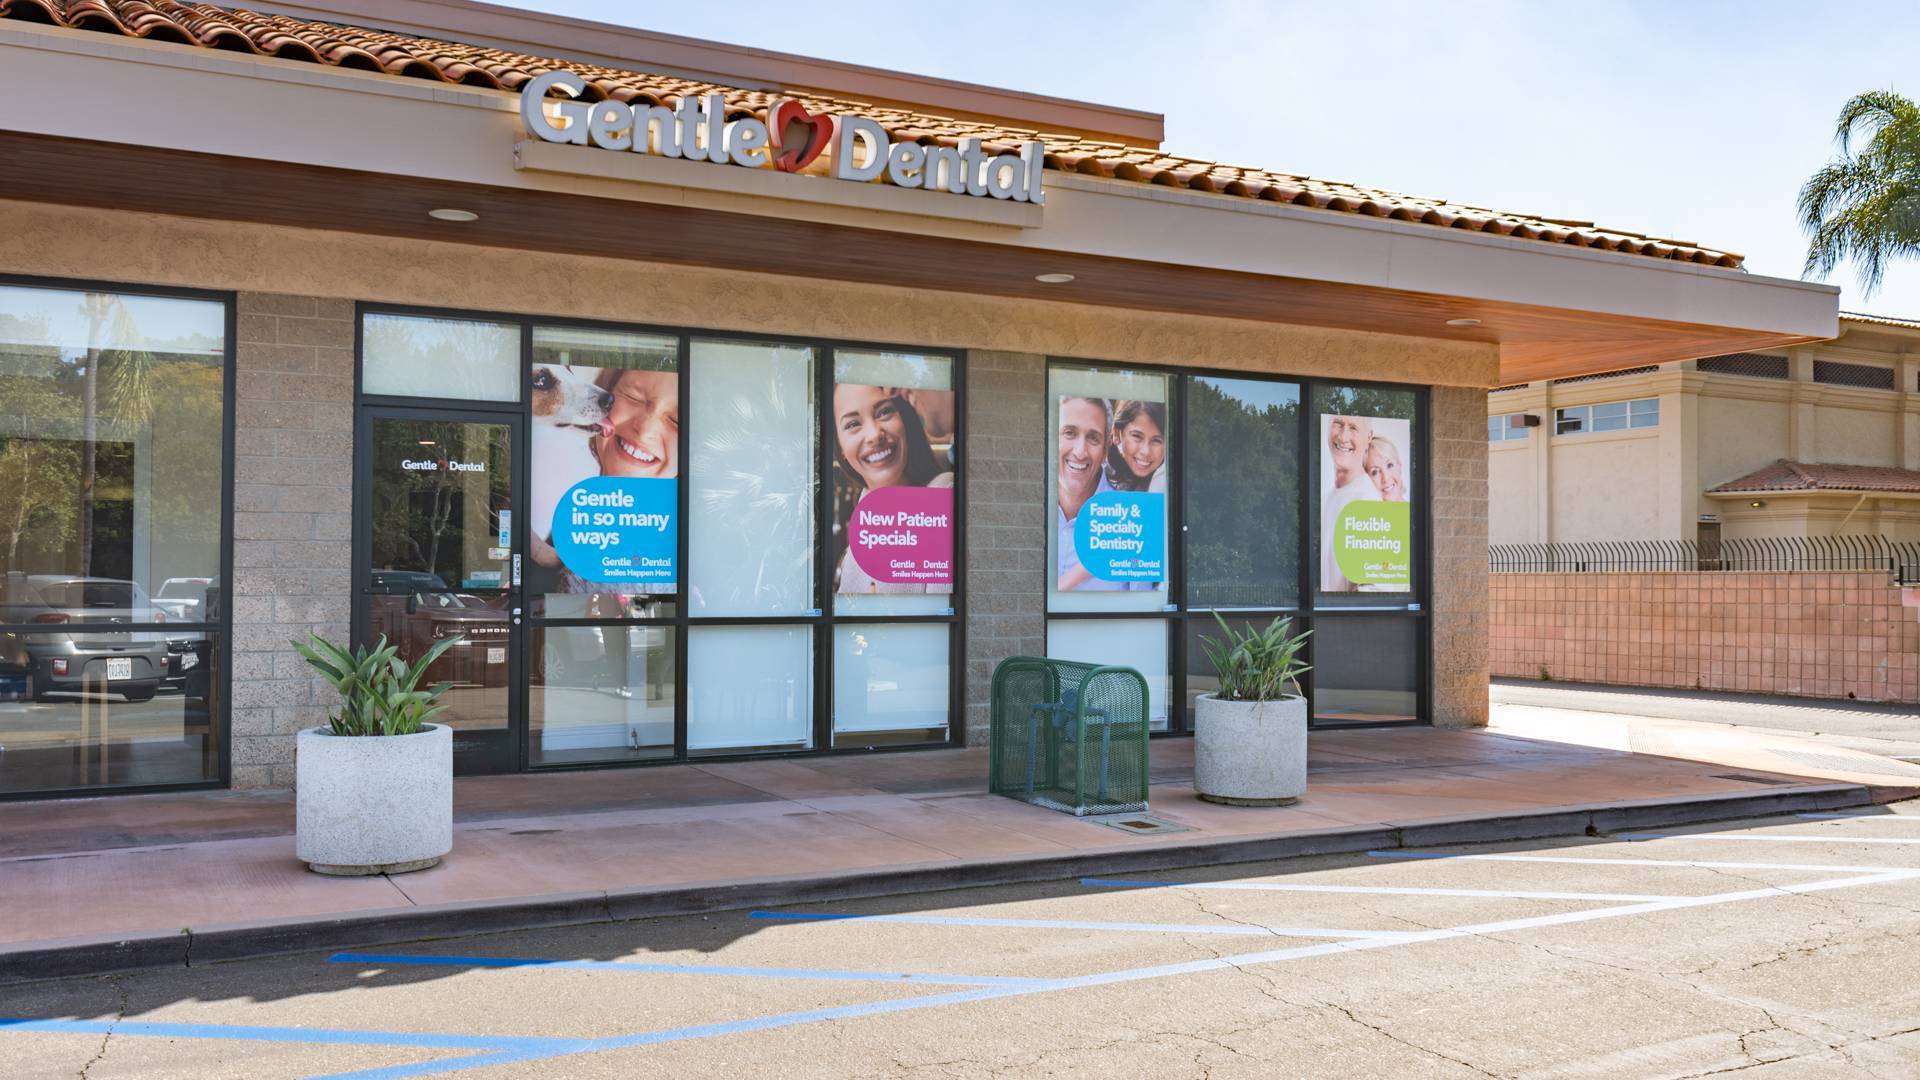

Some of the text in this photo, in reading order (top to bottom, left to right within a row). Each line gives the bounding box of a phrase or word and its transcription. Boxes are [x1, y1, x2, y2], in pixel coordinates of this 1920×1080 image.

[521, 70, 1045, 205] Gentle Dental
[401, 459, 485, 472] Gentle Dental
[571, 488, 635, 508] Gentle
[572, 507, 670, 532] in so many
[859, 510, 948, 528] New Patient
[1090, 503, 1141, 521] Family &
[1089, 519, 1143, 538] Specialty
[1345, 516, 1392, 532] Flexible
[571, 531, 621, 550] ways
[859, 530, 918, 550] Specials
[1090, 536, 1144, 555] Dentistry
[1345, 535, 1401, 554] Financing
[602, 557, 672, 567] Gentle Dental
[890, 560, 949, 569] Gentle Dental
[1110, 560, 1160, 568] Gentle Dental
[604, 569, 672, 579] Smiles Happen Here
[891, 570, 949, 579] Smiles Happen Here
